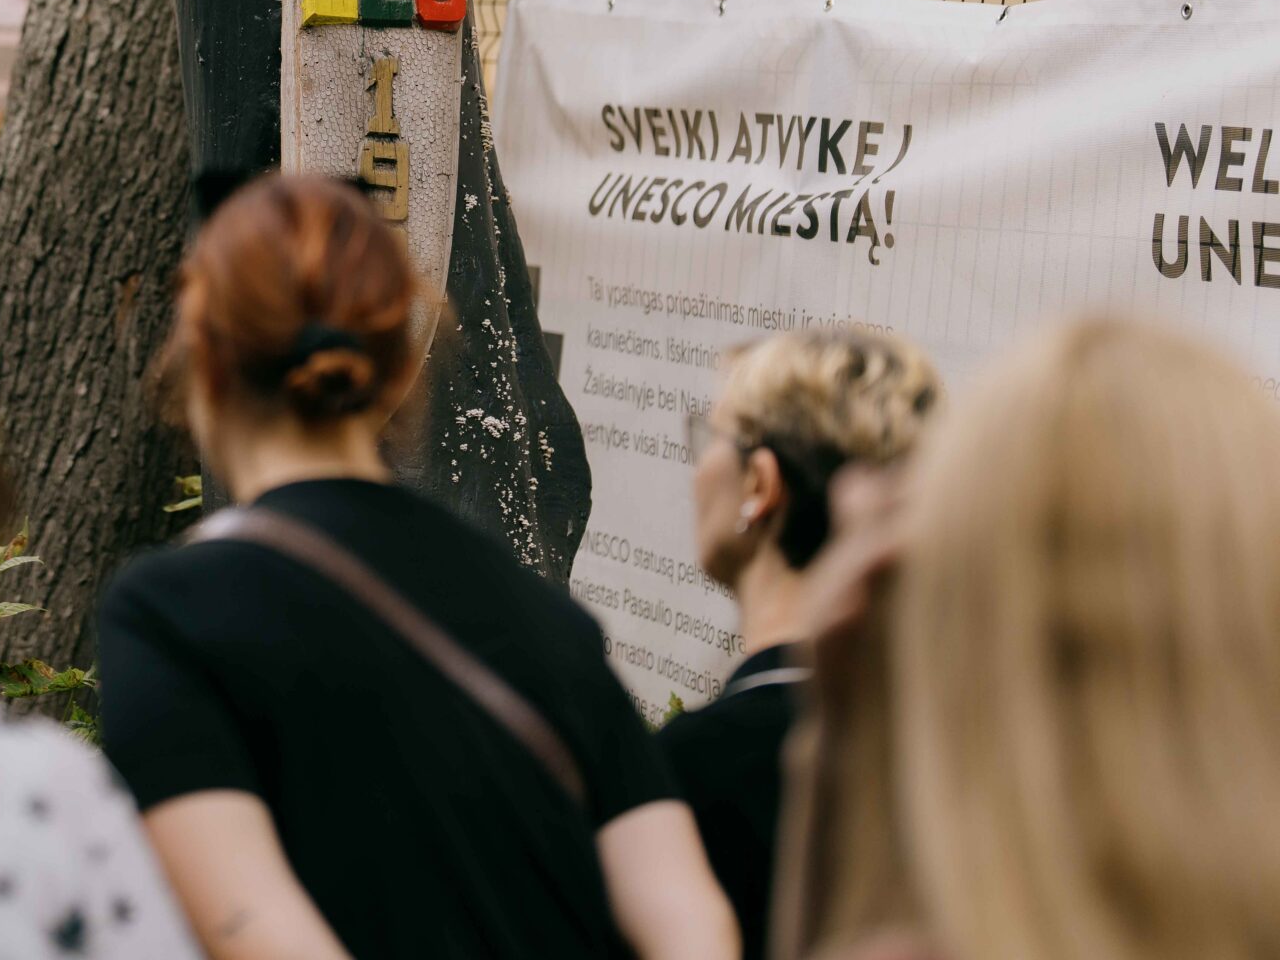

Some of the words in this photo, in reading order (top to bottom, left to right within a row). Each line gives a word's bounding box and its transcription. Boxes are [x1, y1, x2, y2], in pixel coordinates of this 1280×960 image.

[600, 103, 719, 162] SVEIKI
[1154, 121, 1280, 195] WEL
[588, 172, 728, 229] UNESCO
[724, 183, 896, 266] MIESTĄ!
[1151, 212, 1280, 290] UNE
[587, 276, 604, 302] Tai
[606, 282, 664, 315] ypatingas
[665, 290, 745, 326] pripažinimas
[747, 303, 797, 332] miestui
[583, 364, 655, 411] Žaliakalnyje
[658, 384, 678, 412] bei
[632, 428, 659, 458] visai
[579, 528, 631, 563] NESCO
[571, 575, 620, 610] miestas
[622, 588, 673, 627] Pasaulio
[614, 640, 655, 671] masto
